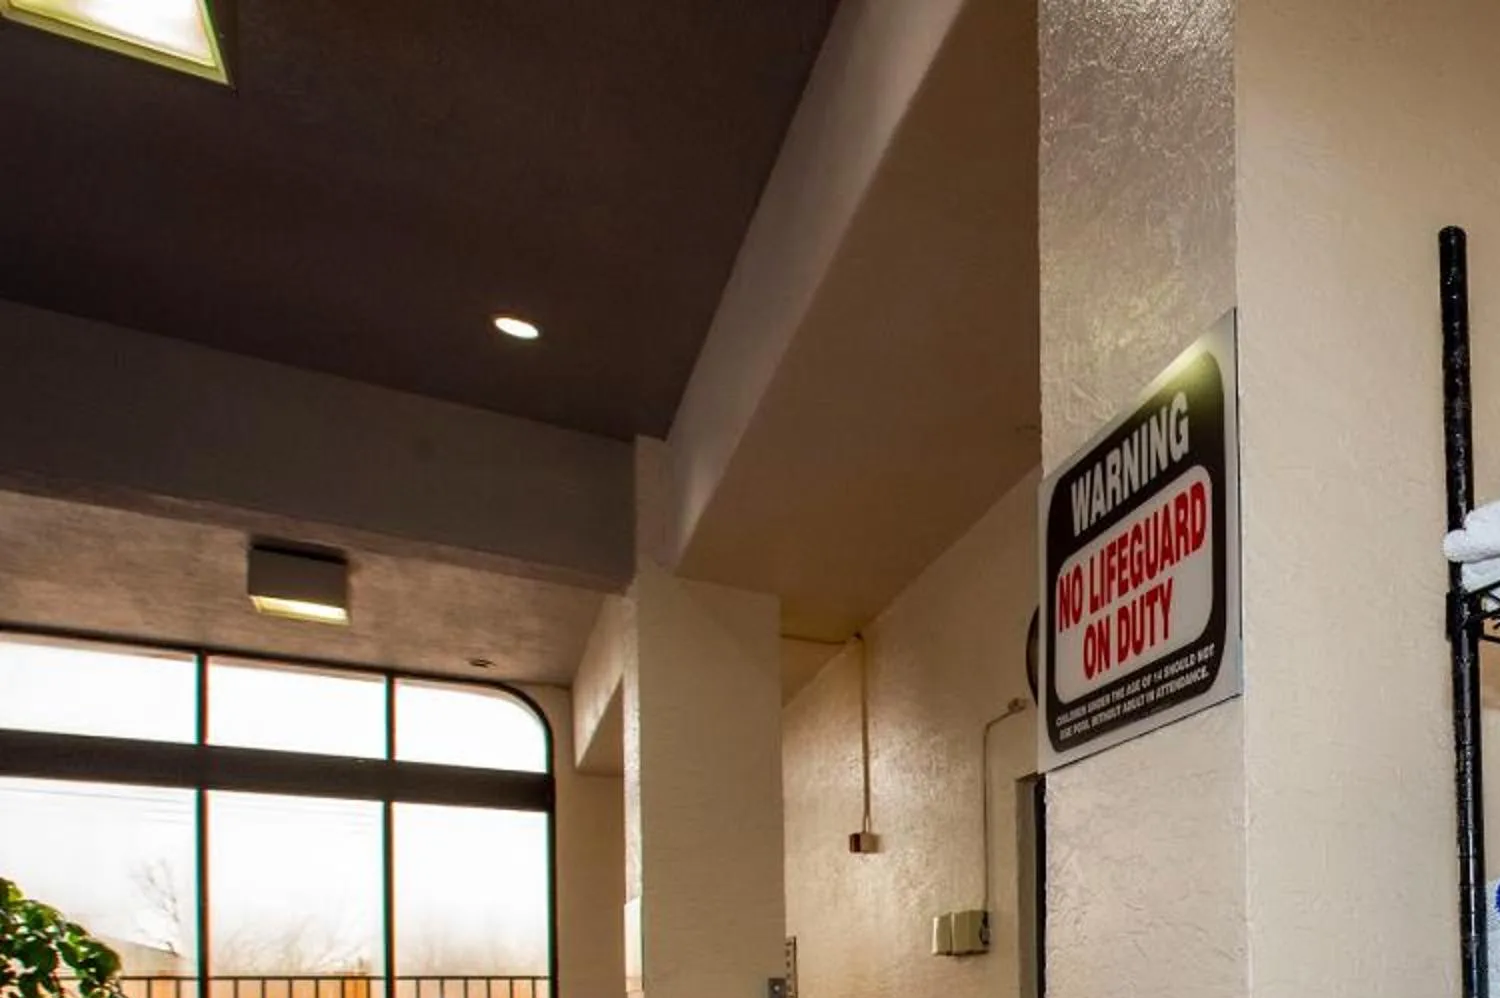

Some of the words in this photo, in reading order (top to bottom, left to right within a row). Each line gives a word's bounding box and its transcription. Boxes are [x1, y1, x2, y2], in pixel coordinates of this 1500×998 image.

[1071, 391, 1190, 538] WARNING
[1059, 564, 1084, 633] NO
[1090, 481, 1207, 617] LIFEGUARD
[1083, 615, 1111, 681] ON
[1118, 576, 1174, 665] DUTY
[1111, 685, 1124, 703] THE
[1126, 679, 1141, 697] AGE
[1141, 673, 1153, 689] OF
[1163, 653, 1197, 680] SHOULD
[1197, 642, 1216, 663] NOT
